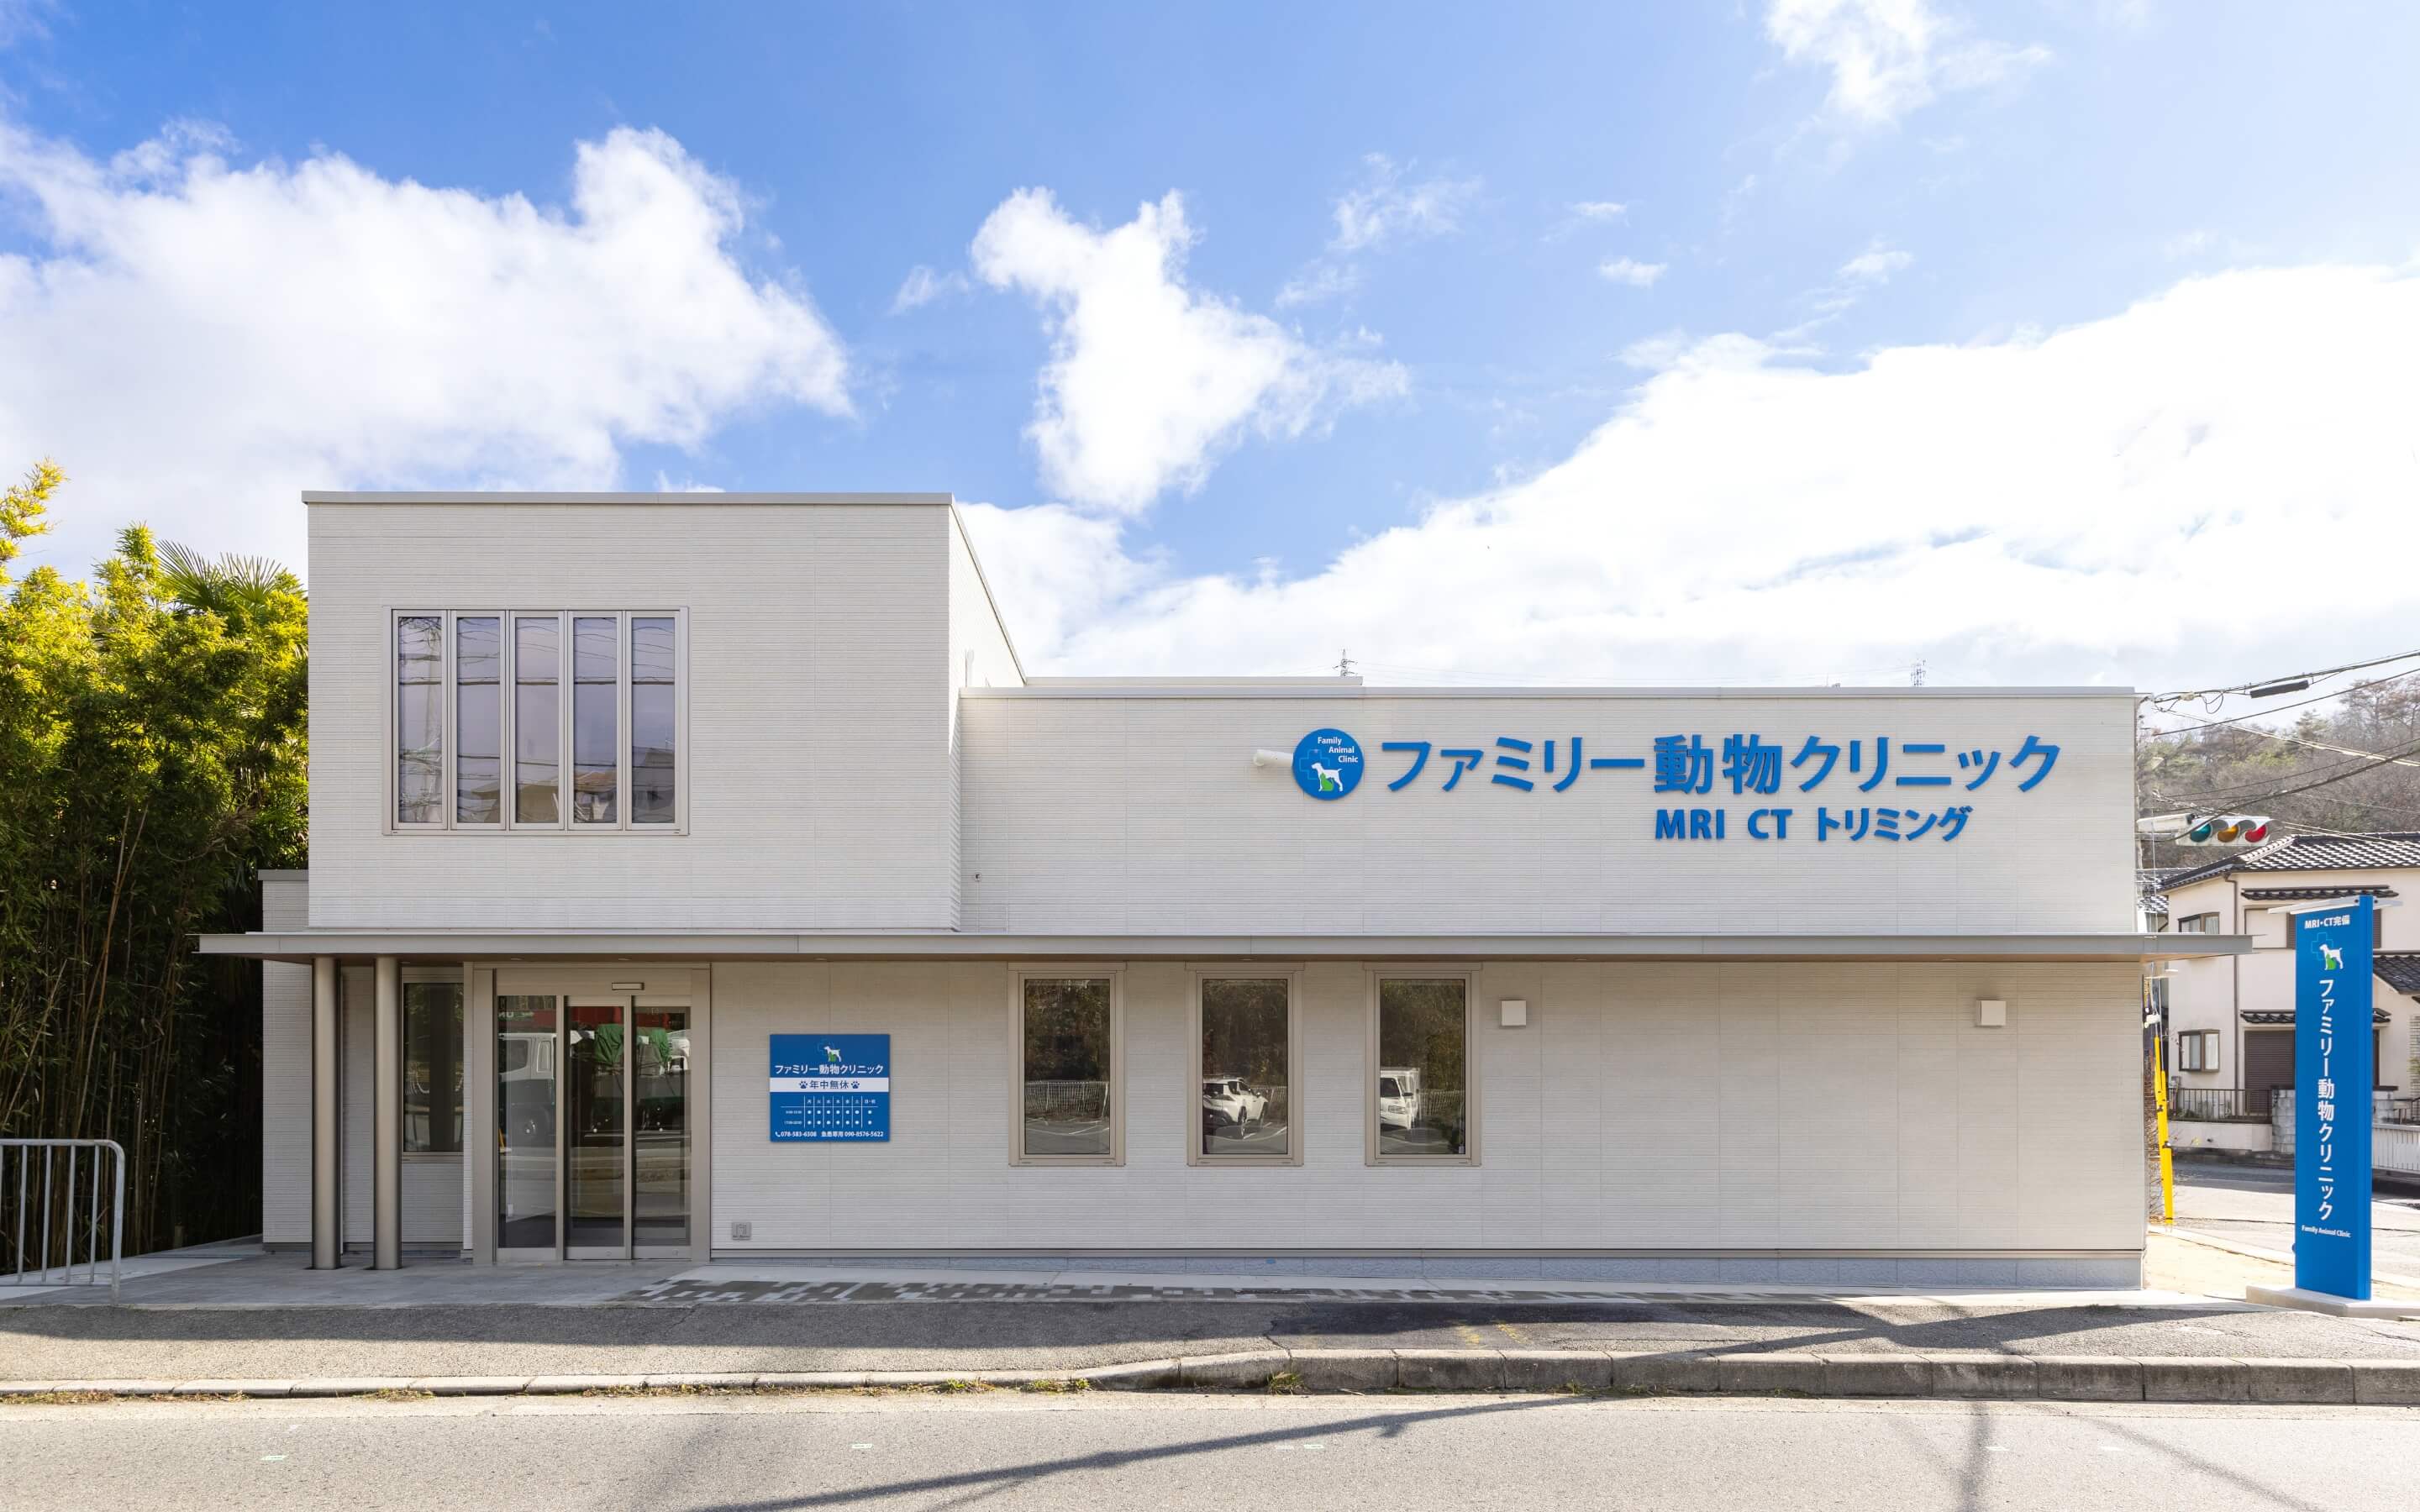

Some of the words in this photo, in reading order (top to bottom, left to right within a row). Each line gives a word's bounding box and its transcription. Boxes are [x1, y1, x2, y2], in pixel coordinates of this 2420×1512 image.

[1317, 736, 1342, 746] Family
[1328, 745, 1355, 753] Animal
[1381, 732, 2061, 795] ファミリー動物クリニック
[1655, 808, 1726, 840] MRI
[1747, 808, 1793, 840] CT
[1817, 806, 1973, 842] トリミング
[775, 1063, 884, 1075] ファミリー動物クリニック
[809, 1080, 850, 1089] 年中無休
[2317, 979, 2336, 1221] ファミリー動物クリニック
